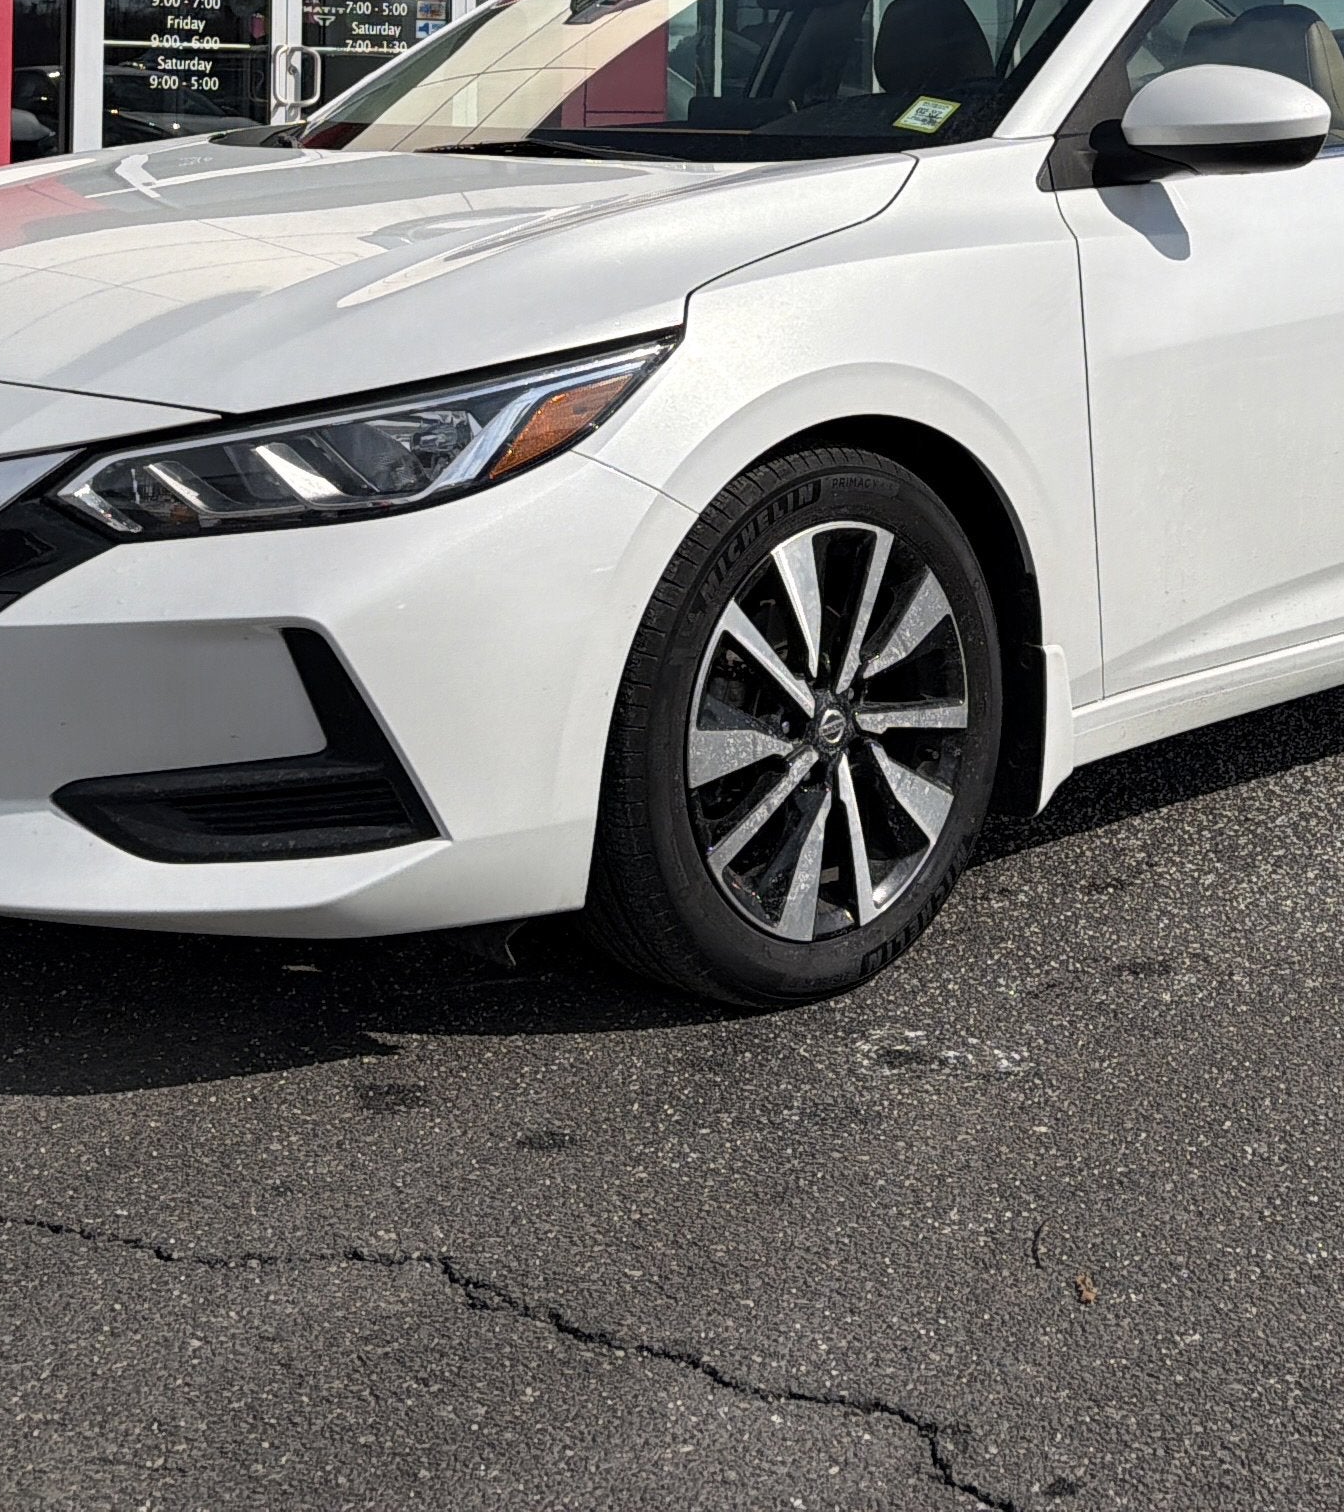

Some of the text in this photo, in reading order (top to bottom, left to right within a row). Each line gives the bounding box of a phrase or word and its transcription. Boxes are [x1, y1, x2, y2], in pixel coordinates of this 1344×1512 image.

[346, 1, 372, 14] 7:00
[382, 2, 408, 16] 5:00
[167, 15, 206, 33] Friday
[352, 21, 402, 37] Saturday
[151, 34, 180, 48] 9:00
[191, 35, 220, 49] 6:00
[346, 40, 372, 53] 7:00
[382, 40, 408, 54] 1:30
[157, 55, 213, 73] Saturday
[149, 75, 179, 89] 9:00
[191, 77, 219, 90] 5:00
[699, 477, 879, 602] MICHELIN PRIMACY
